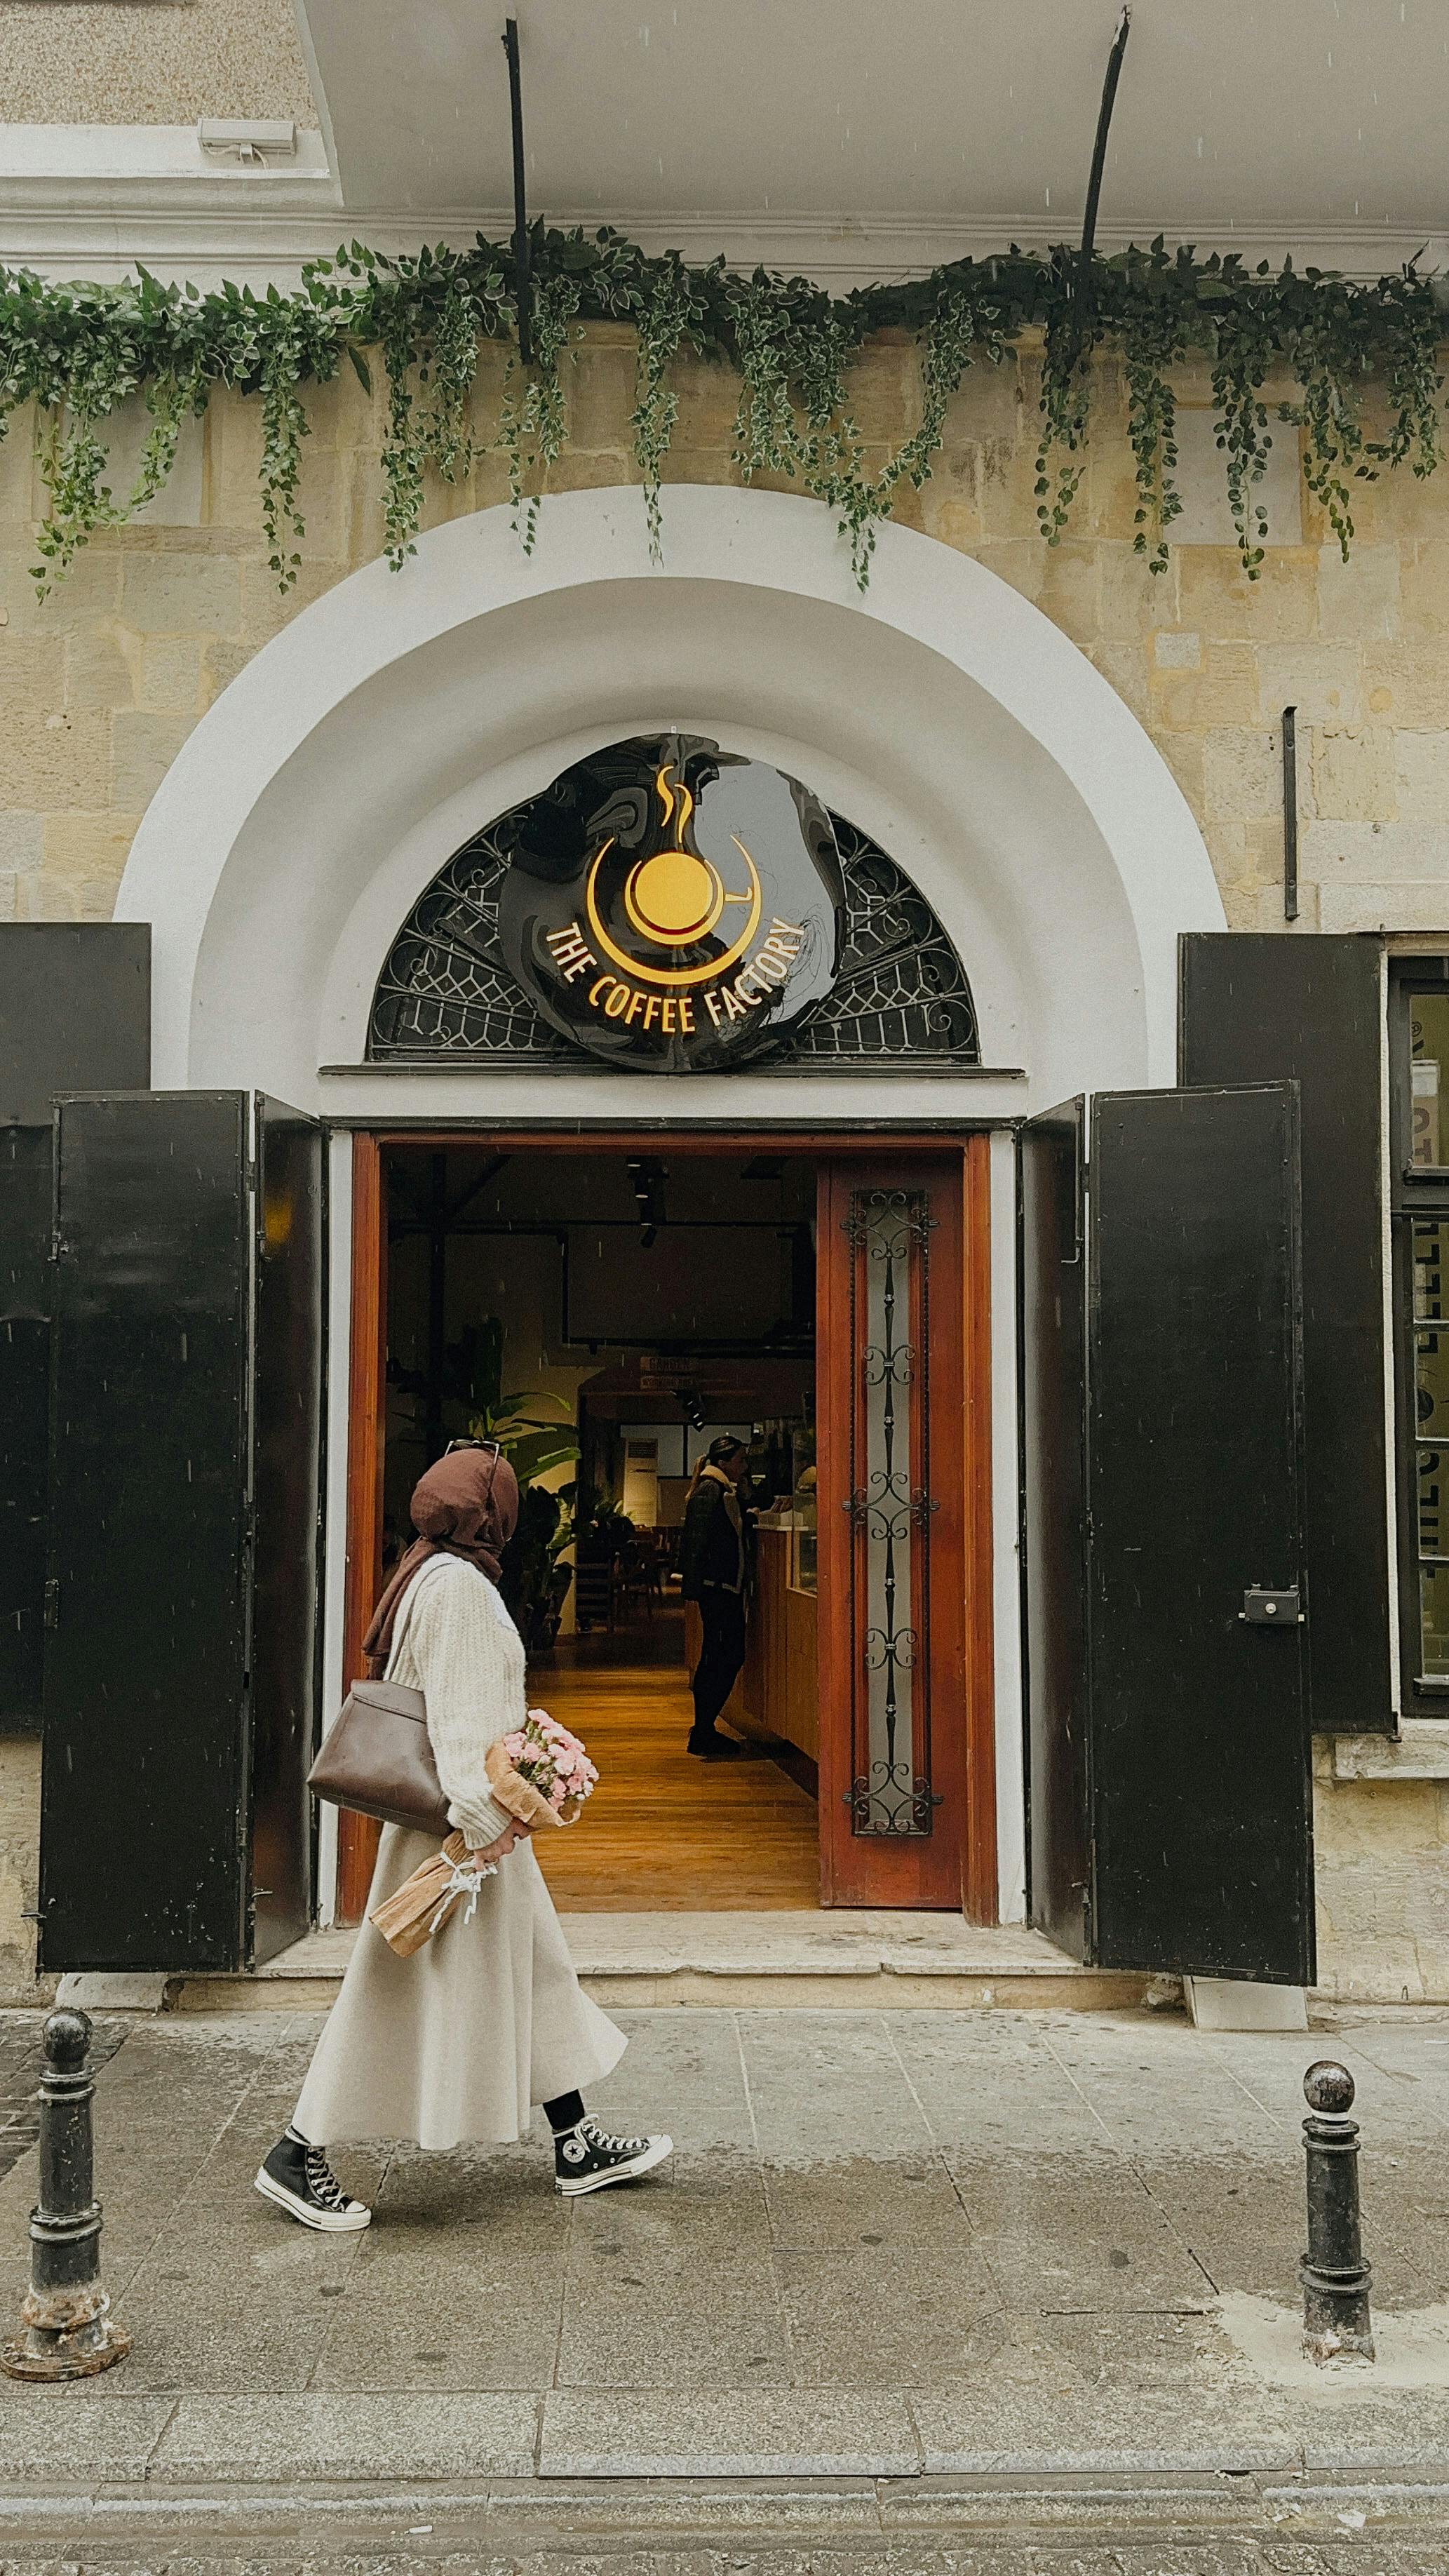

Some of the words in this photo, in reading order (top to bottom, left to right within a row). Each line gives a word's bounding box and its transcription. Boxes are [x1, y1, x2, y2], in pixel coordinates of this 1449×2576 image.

[546, 923, 597, 983] THE
[588, 976, 695, 1033] COFFEE
[704, 918, 805, 1026] FACTORY
